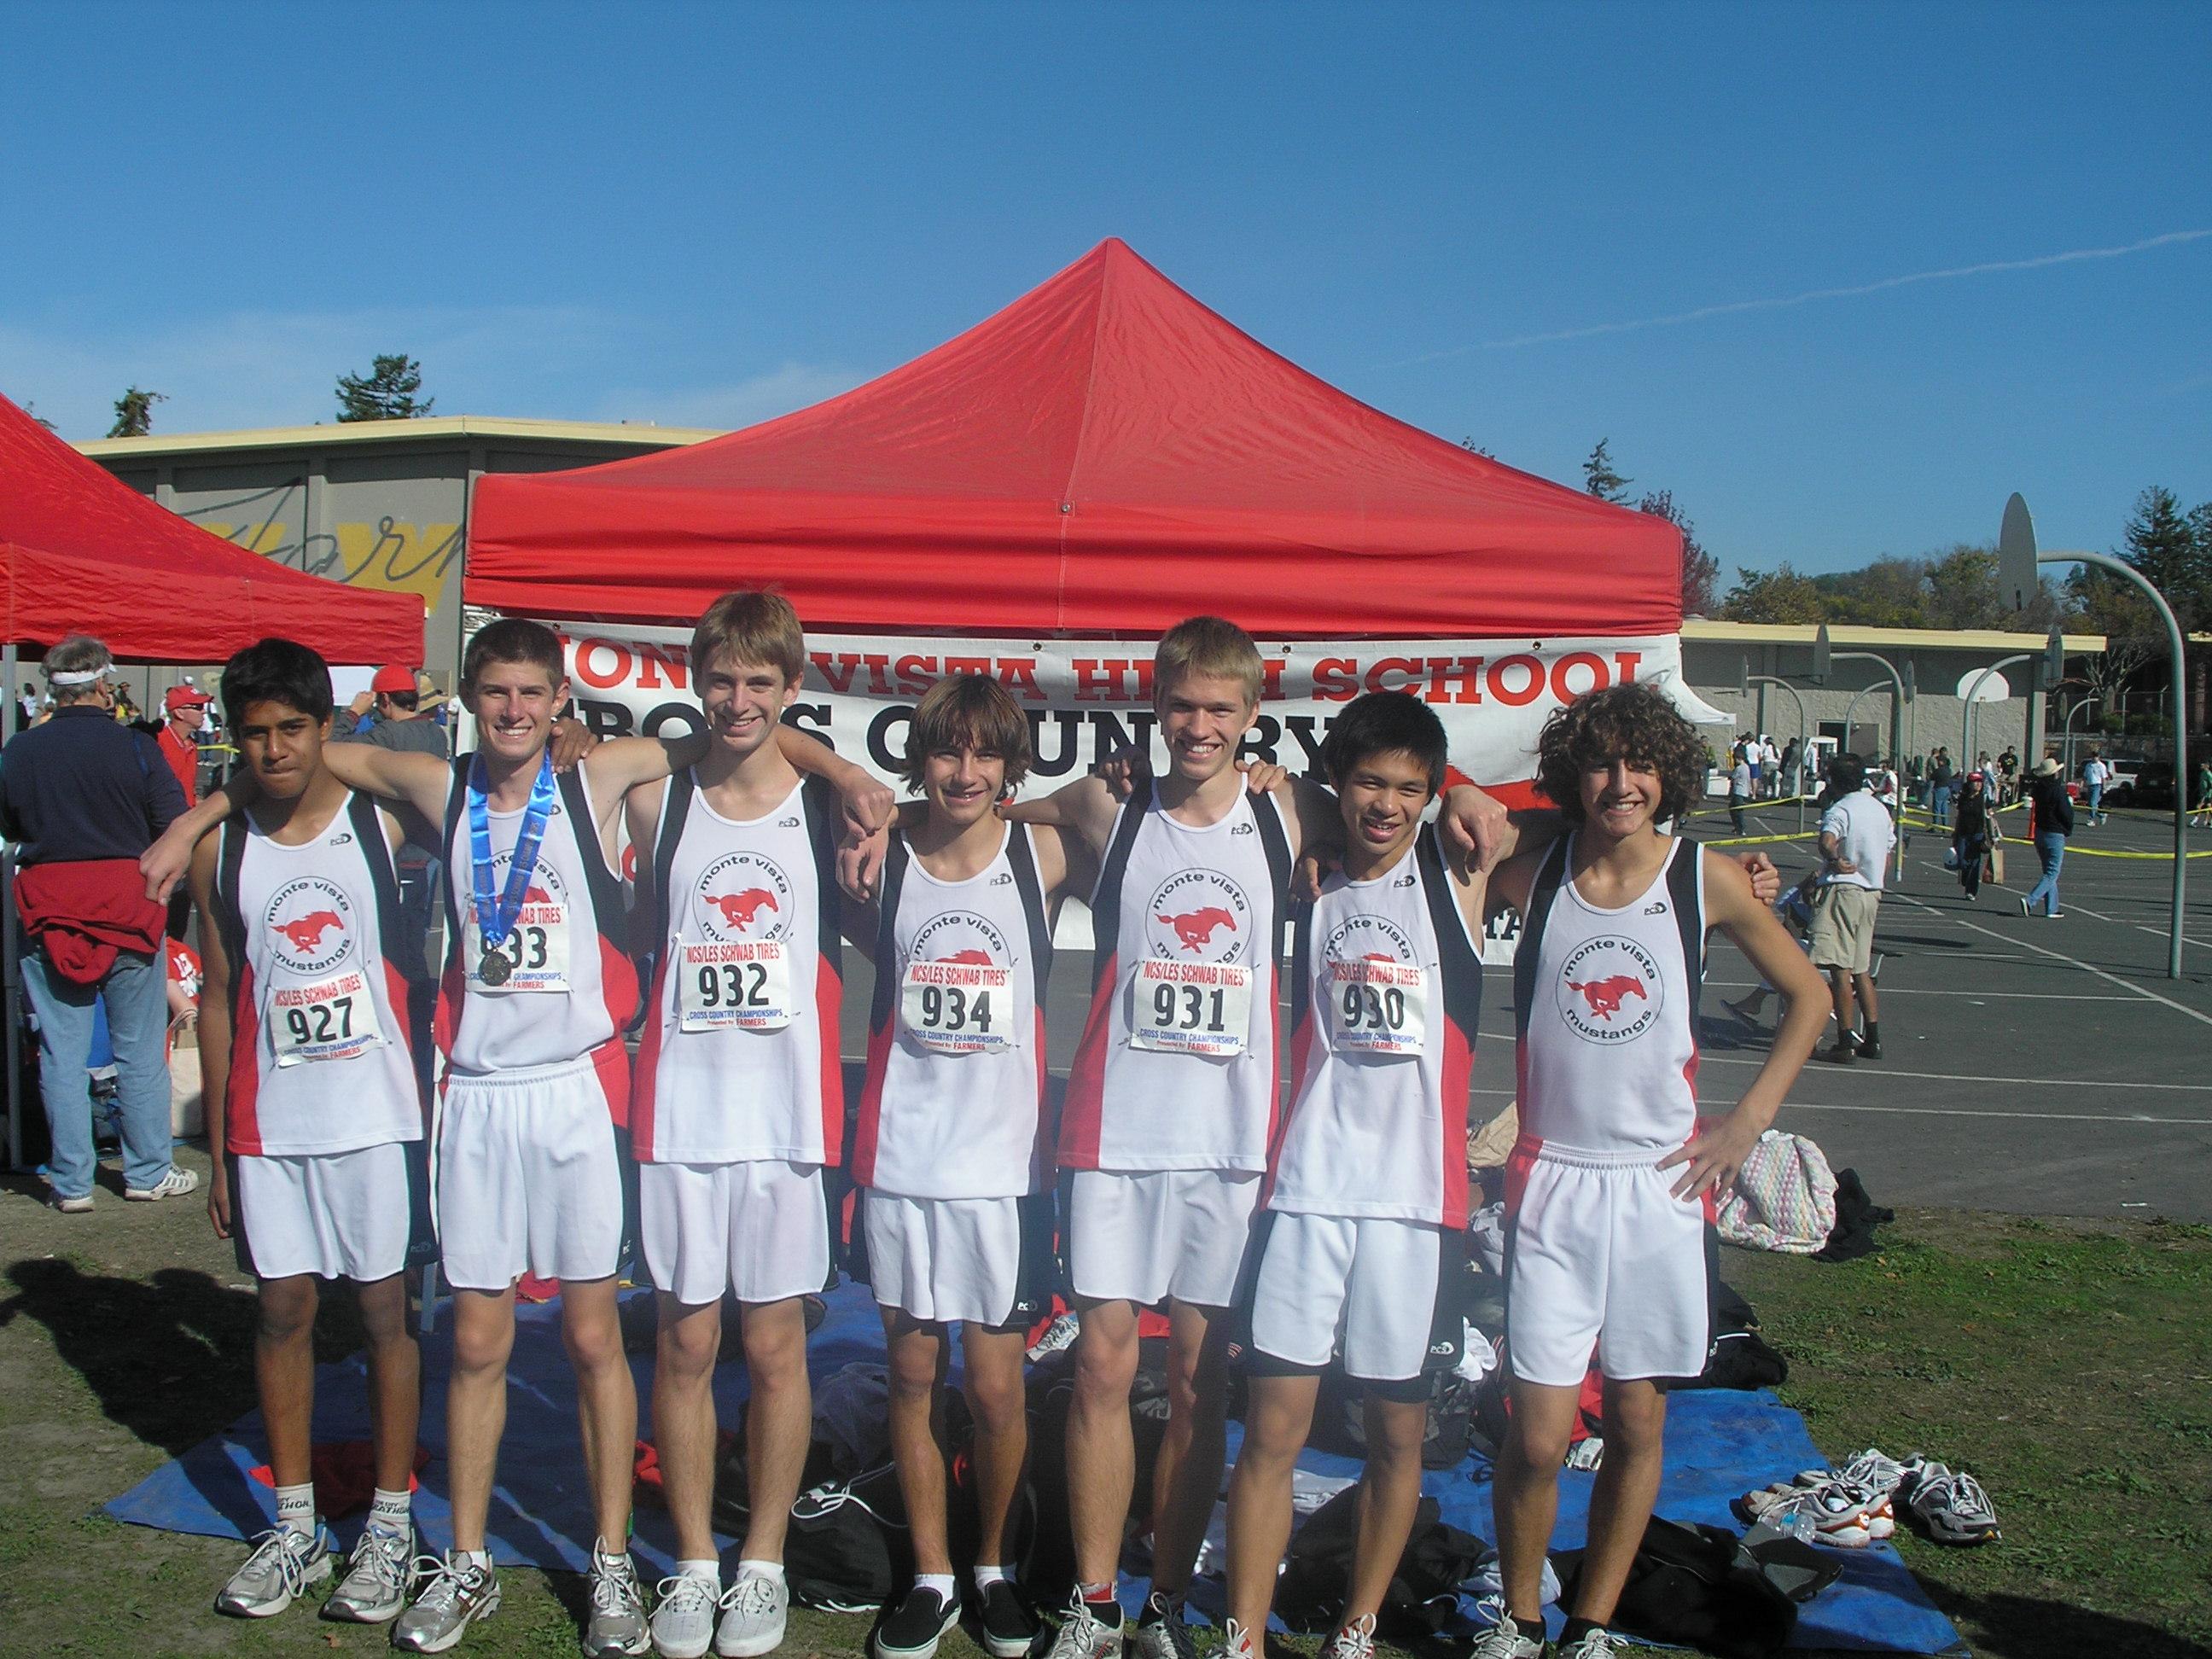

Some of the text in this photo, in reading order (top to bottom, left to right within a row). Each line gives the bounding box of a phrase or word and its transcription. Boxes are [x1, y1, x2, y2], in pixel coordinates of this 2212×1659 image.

[700, 856, 787, 894] monte vista
[268, 882, 349, 922] monte vista
[1153, 873, 1245, 911] monte vista
[537, 906, 561, 923] TIRES
[1644, 902, 1667, 915] PCS
[914, 916, 1002, 955] monte vista
[1377, 922, 1411, 959] vista
[276, 939, 350, 970] mustangs
[720, 944, 755, 963] SCHWAB
[756, 943, 780, 960] TIRES
[1564, 940, 1656, 980] monte vista
[339, 973, 361, 995] TIRES
[698, 963, 769, 1007] 932
[911, 964, 1006, 987] NCS/LES SCHWAB TIRES
[1144, 961, 1244, 987] NCS/LES SCHWAB TIRES
[1396, 967, 1420, 986] TIRES
[287, 996, 352, 1045] 927
[708, 1010, 734, 1019] COUNTRY
[736, 1009, 783, 1017] CHAMPIONSHIPS
[923, 986, 992, 1033] 934
[1154, 983, 1225, 1032] 931
[1343, 984, 1405, 1030] 930
[928, 1031, 953, 1041] COUNTRY
[955, 1033, 1004, 1044] CHAMPIONSHIPS
[1139, 1028, 1239, 1045] CROSS COUNTRY CHAMPIONSHIPS
[1567, 1009, 1652, 1039] mustangs
[953, 1042, 986, 1051] FARMERS
[1187, 1043, 1220, 1052] FARMERS
[1430, 1342, 1455, 1355] PCS
